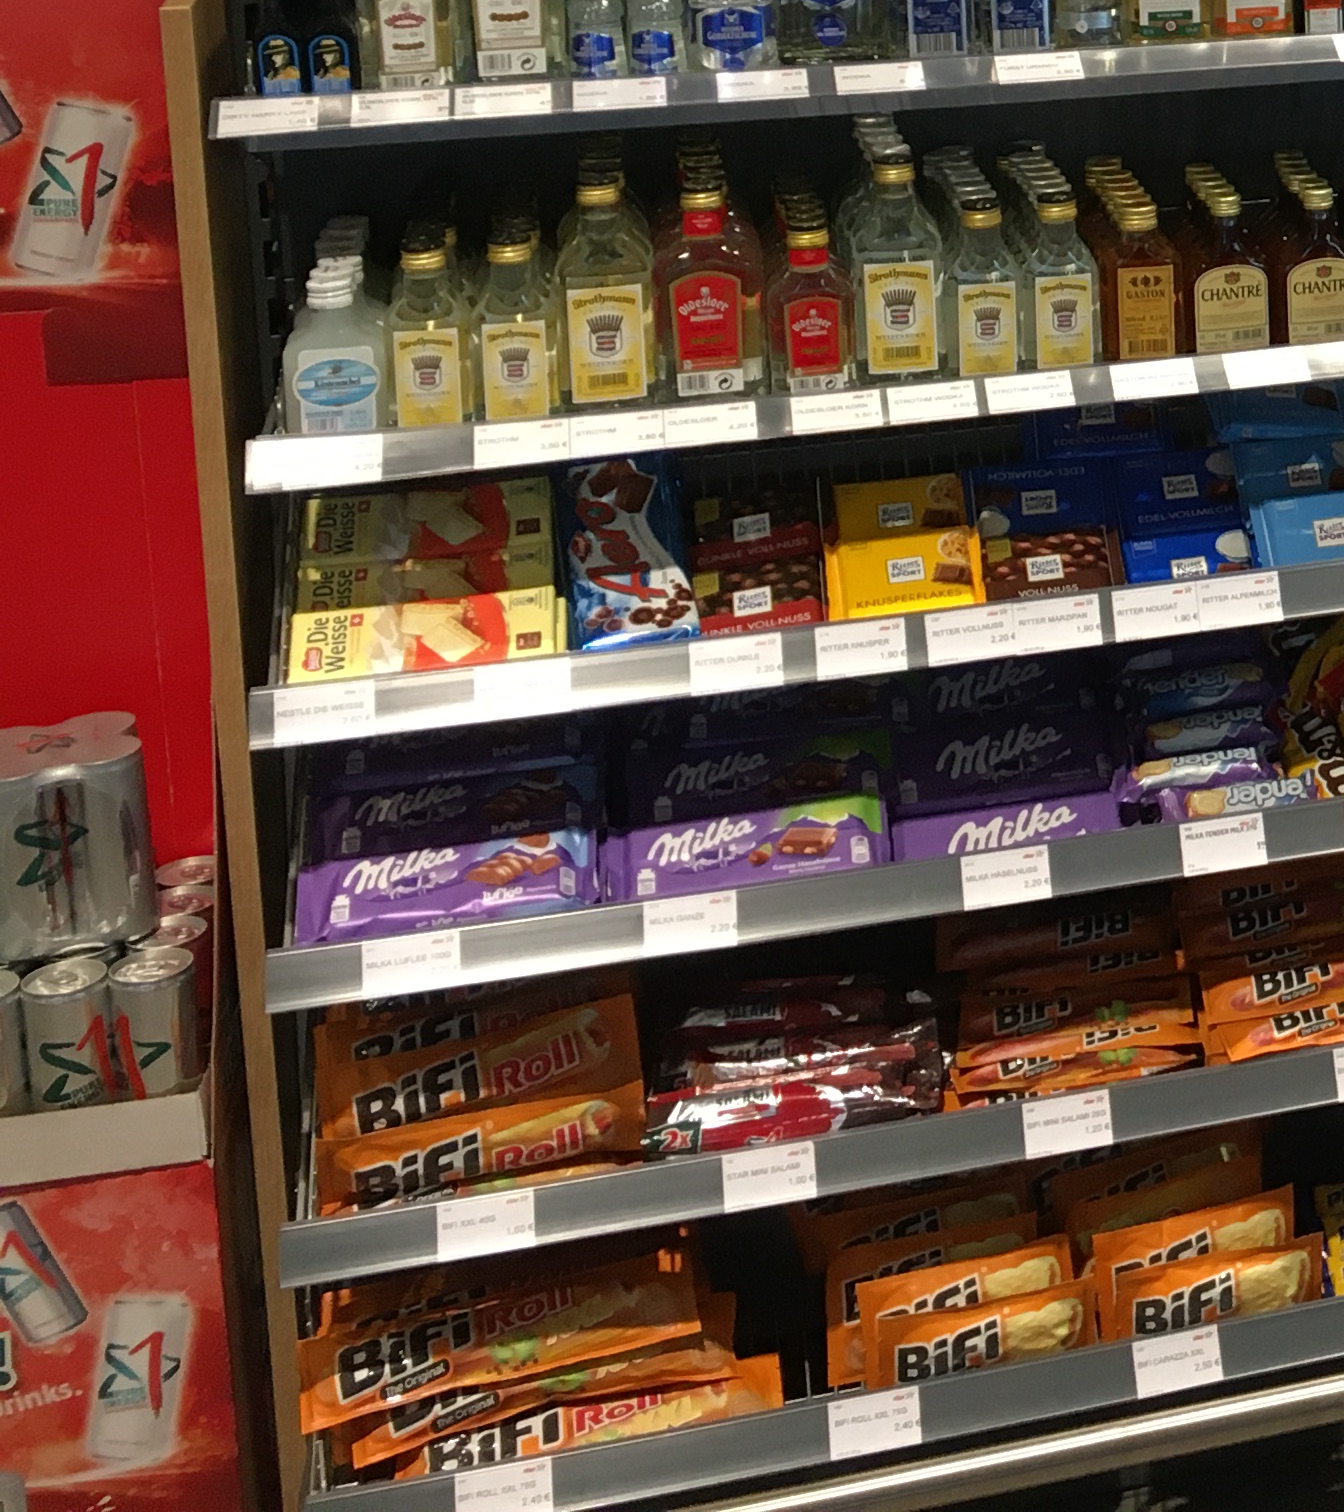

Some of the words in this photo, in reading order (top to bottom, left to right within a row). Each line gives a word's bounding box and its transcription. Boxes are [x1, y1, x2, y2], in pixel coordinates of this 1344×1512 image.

[33, 207, 78, 217] ENERGY
[45, 197, 78, 208] PURE
[571, 292, 637, 309] Strothmann
[1200, 283, 1263, 303] CHANTRÉ
[1116, 607, 1143, 617] RITTER
[1145, 602, 1178, 614] NOUGAT
[646, 817, 757, 868] Milka
[342, 844, 461, 896] Milka
[352, 1126, 482, 1206] BiFi
[494, 1122, 585, 1172] Roll
[0, 1382, 83, 1416] rinks.
